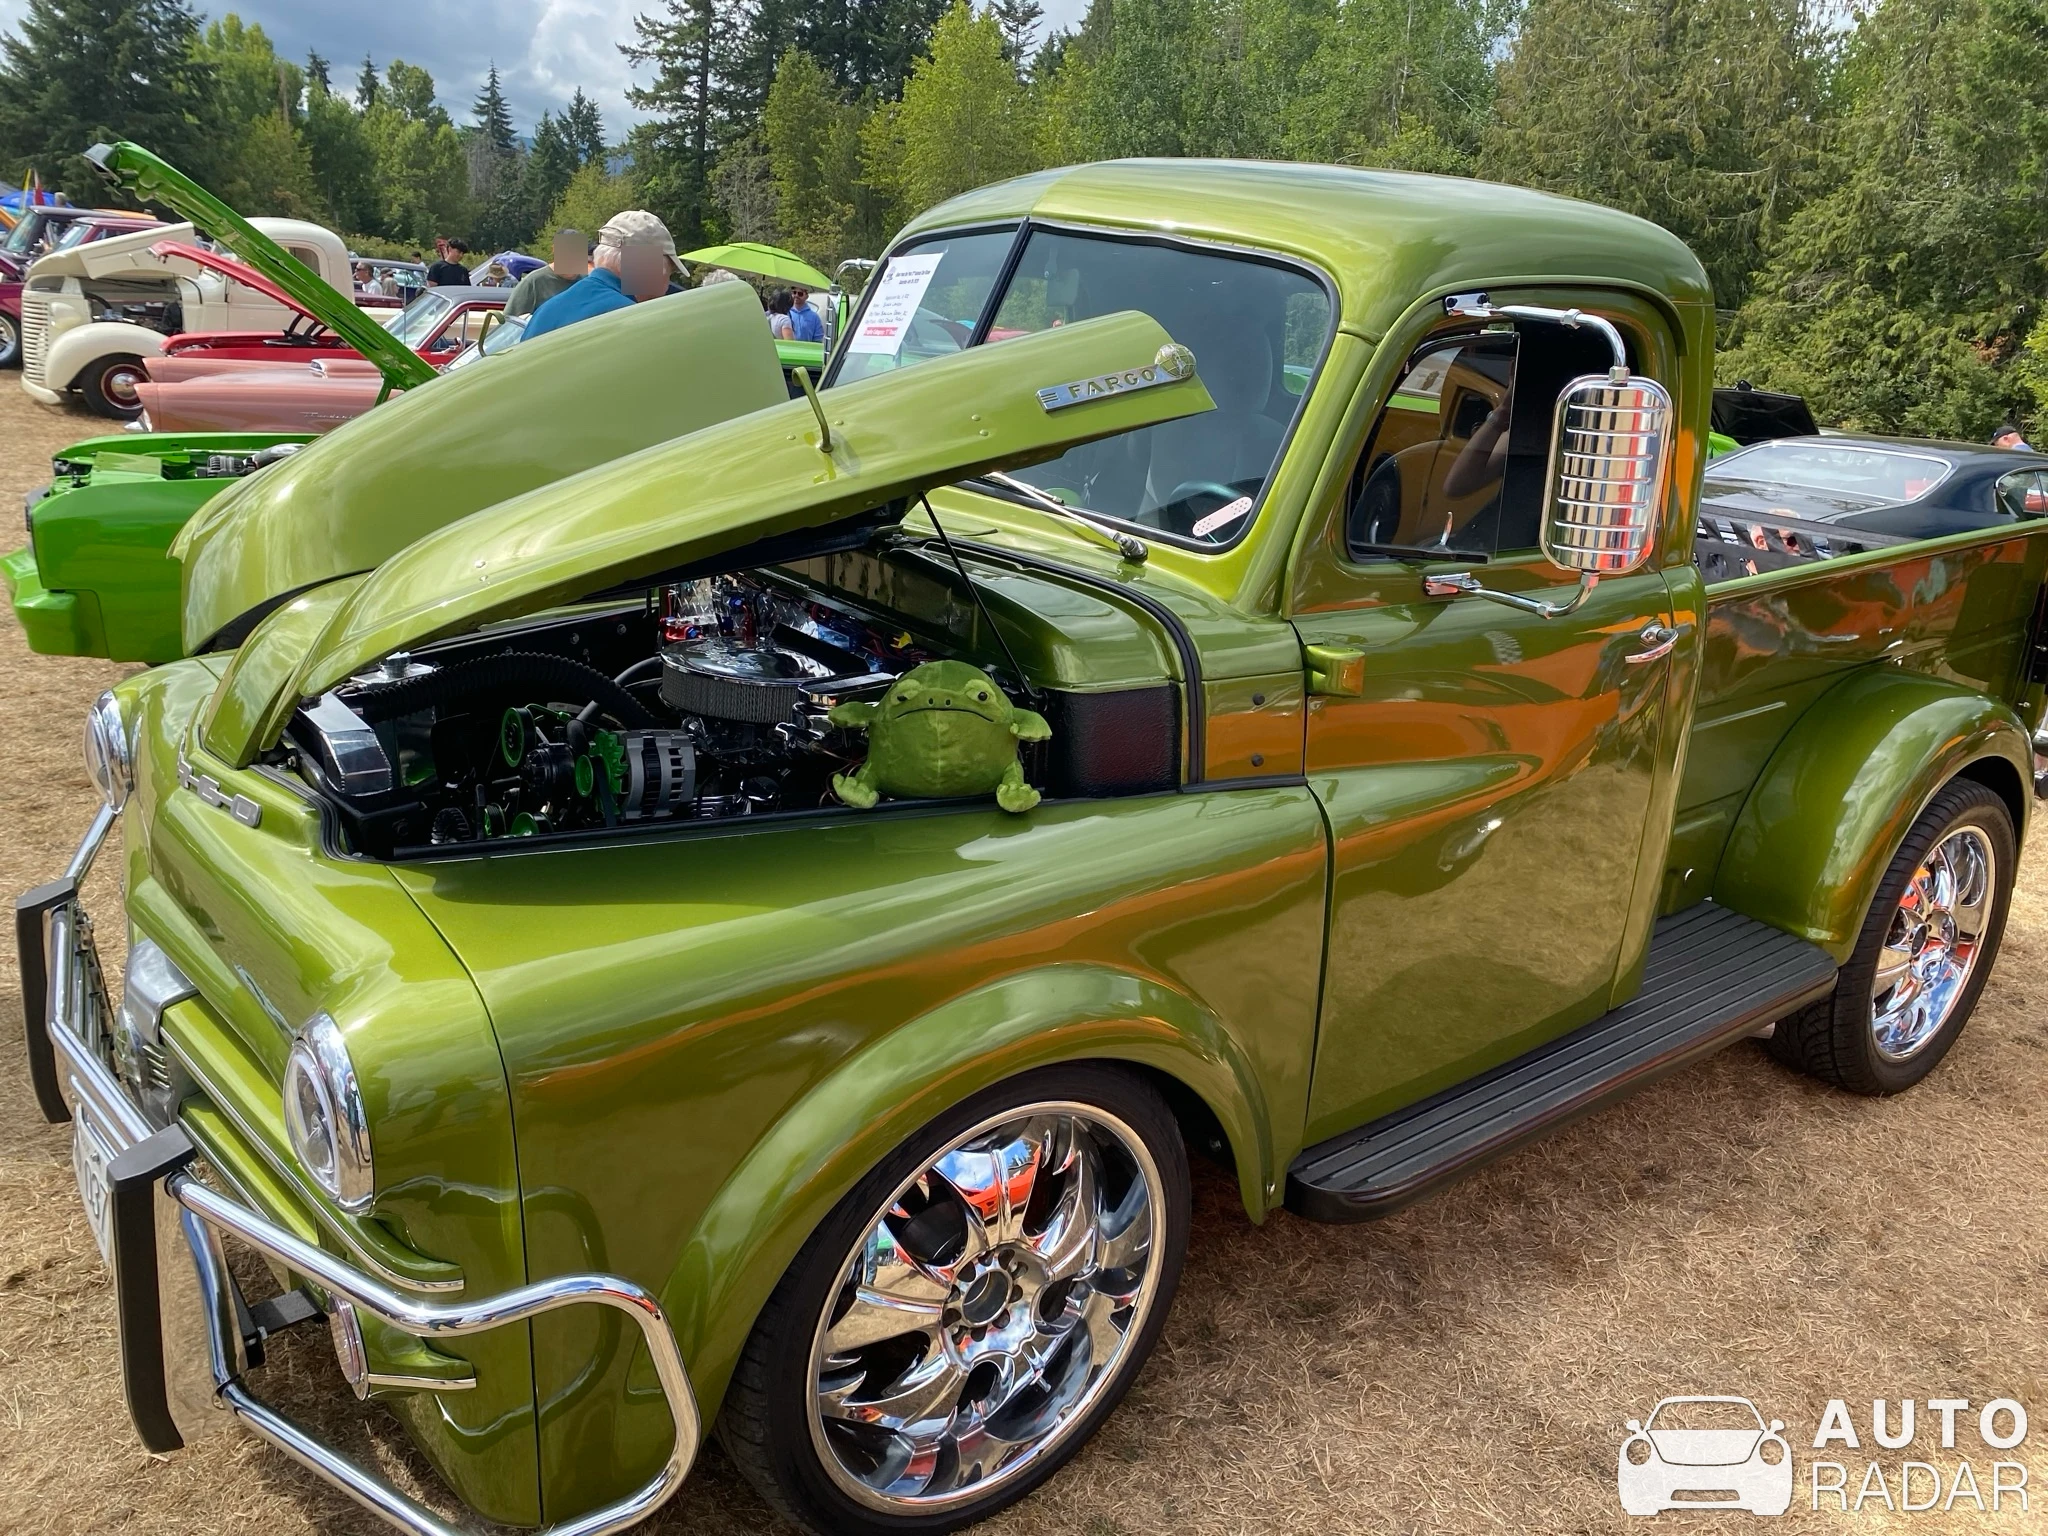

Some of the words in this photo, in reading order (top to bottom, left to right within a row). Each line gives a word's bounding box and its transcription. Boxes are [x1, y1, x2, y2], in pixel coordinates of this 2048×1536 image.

[1068, 369, 1157, 399] FARGO
[299, 411, 355, 420] Thunderb
[177, 747, 262, 829] RGO
